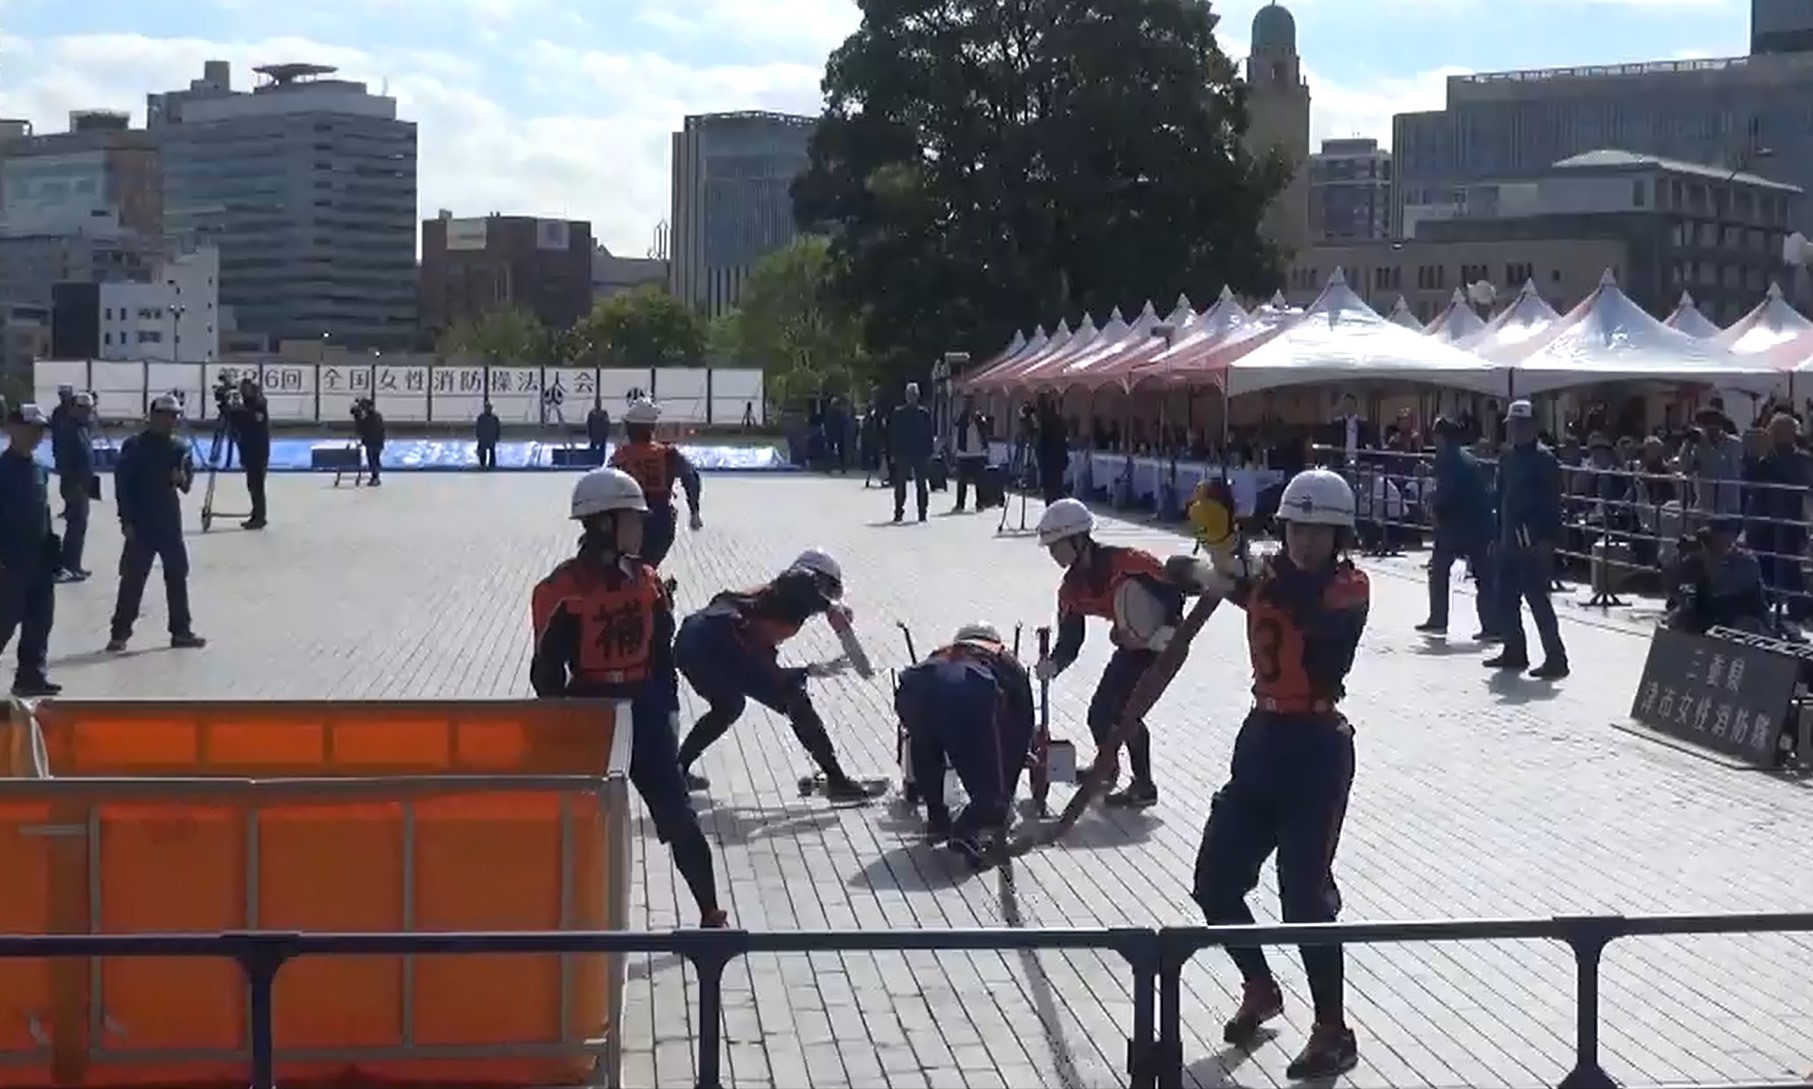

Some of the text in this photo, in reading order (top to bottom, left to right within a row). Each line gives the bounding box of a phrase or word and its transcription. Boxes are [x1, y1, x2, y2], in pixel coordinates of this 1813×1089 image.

[592, 597, 644, 659] 補
[1254, 617, 1283, 683] 3
[1685, 649, 1745, 693] 三重県
